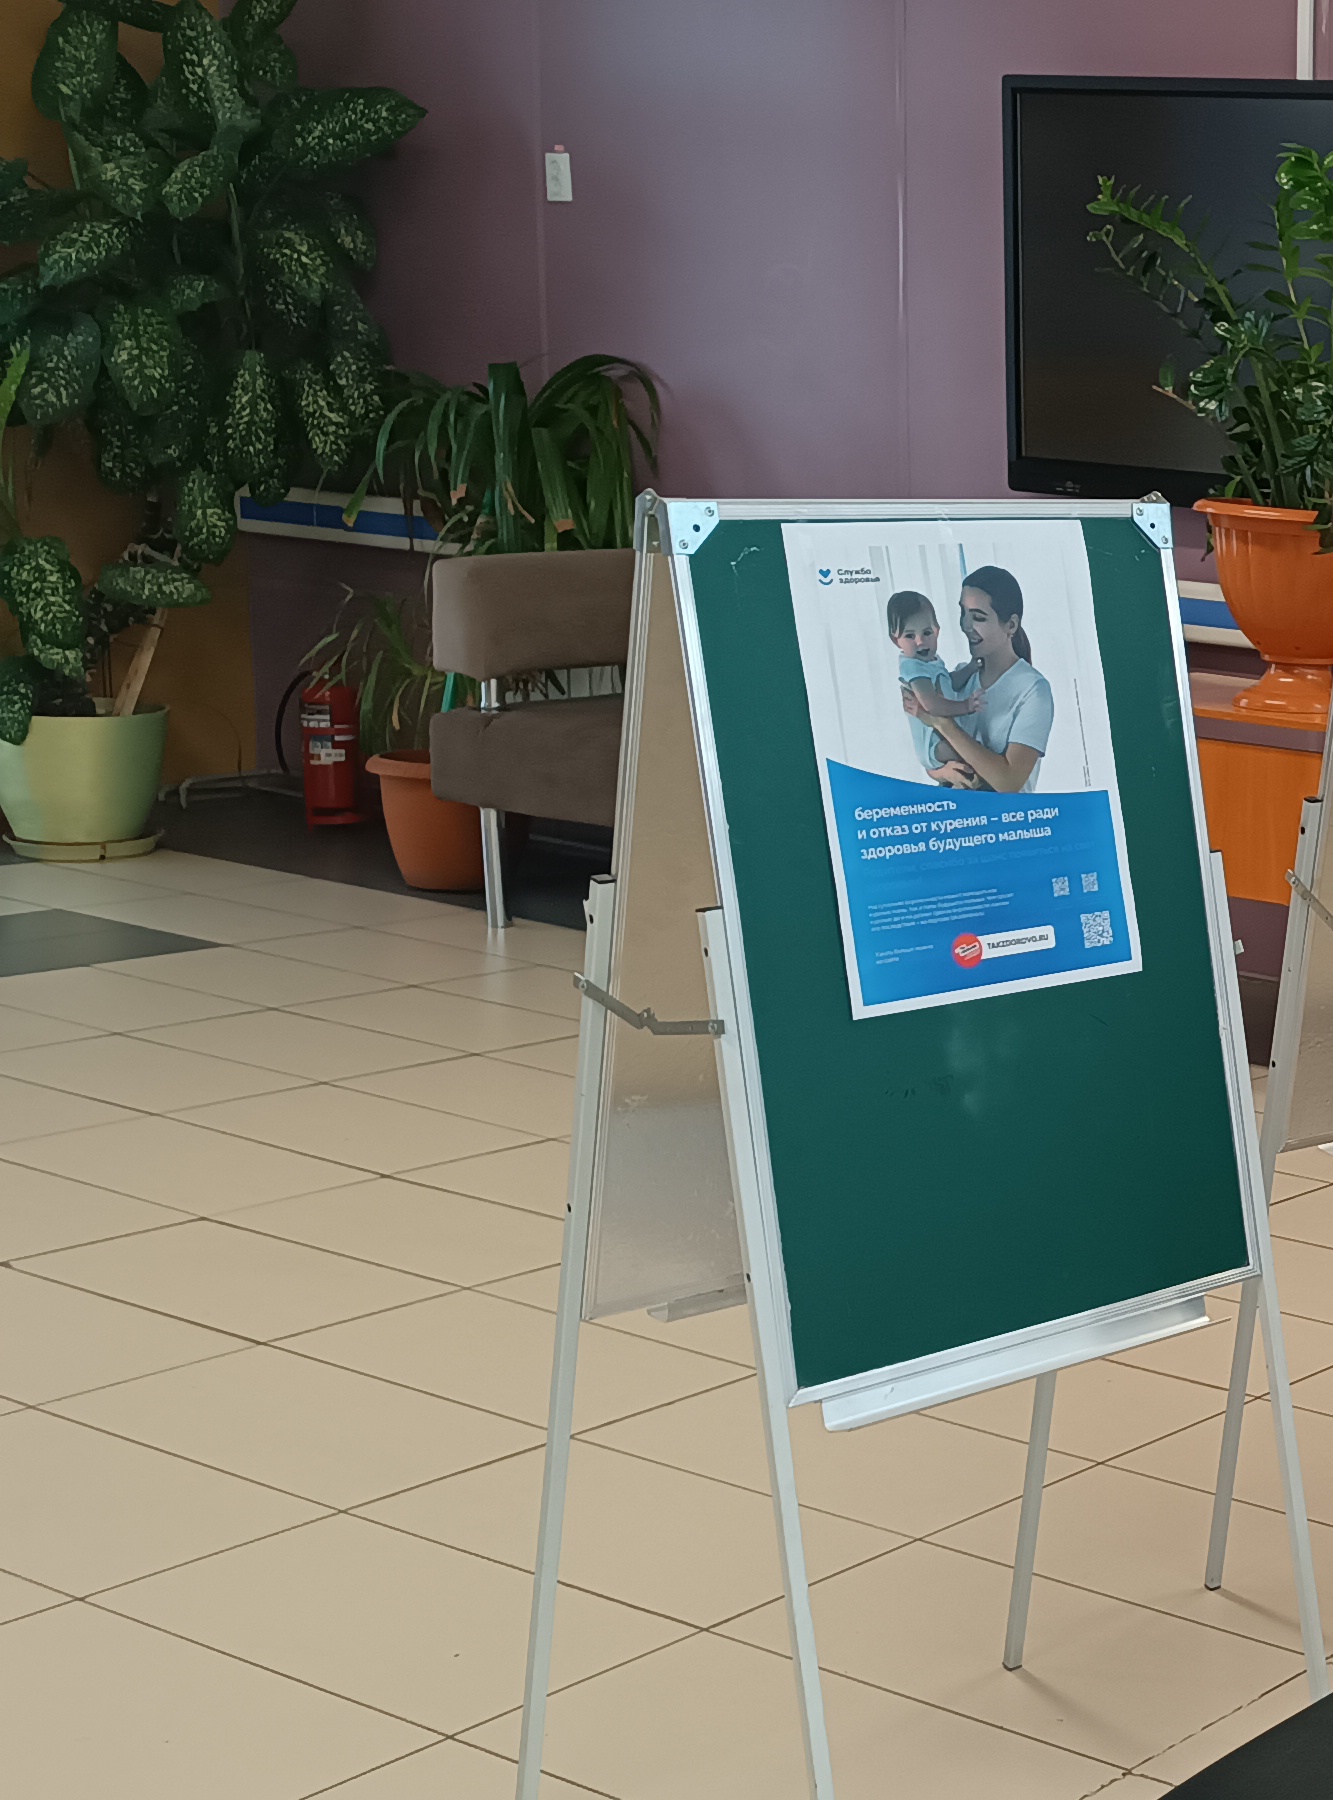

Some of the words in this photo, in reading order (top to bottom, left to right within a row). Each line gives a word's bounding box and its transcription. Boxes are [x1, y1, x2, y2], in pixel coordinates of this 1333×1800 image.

[837, 568, 871, 577] Служба
[854, 800, 957, 822] беременность
[857, 828, 866, 840] и
[870, 824, 910, 840] отказ
[912, 822, 928, 834] от
[930, 814, 988, 834] курения
[1002, 810, 1025, 823] все
[1028, 806, 1060, 822] ради
[860, 842, 926, 860] здоровья
[928, 832, 996, 854] будущего
[998, 826, 1052, 842] малыша
